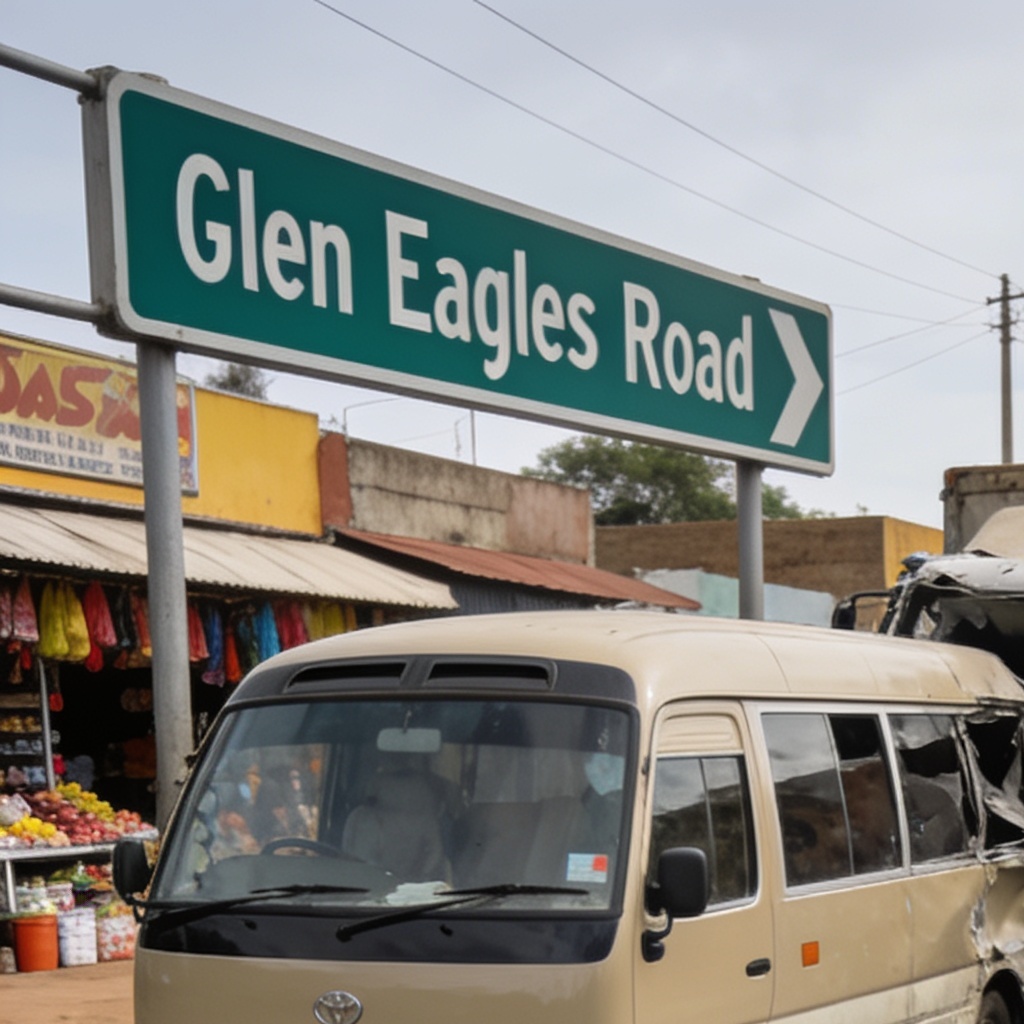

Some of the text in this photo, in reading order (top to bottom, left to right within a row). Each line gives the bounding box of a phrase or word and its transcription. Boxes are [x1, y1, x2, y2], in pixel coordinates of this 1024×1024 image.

[175, 153, 755, 412] Glen Eagles Road
